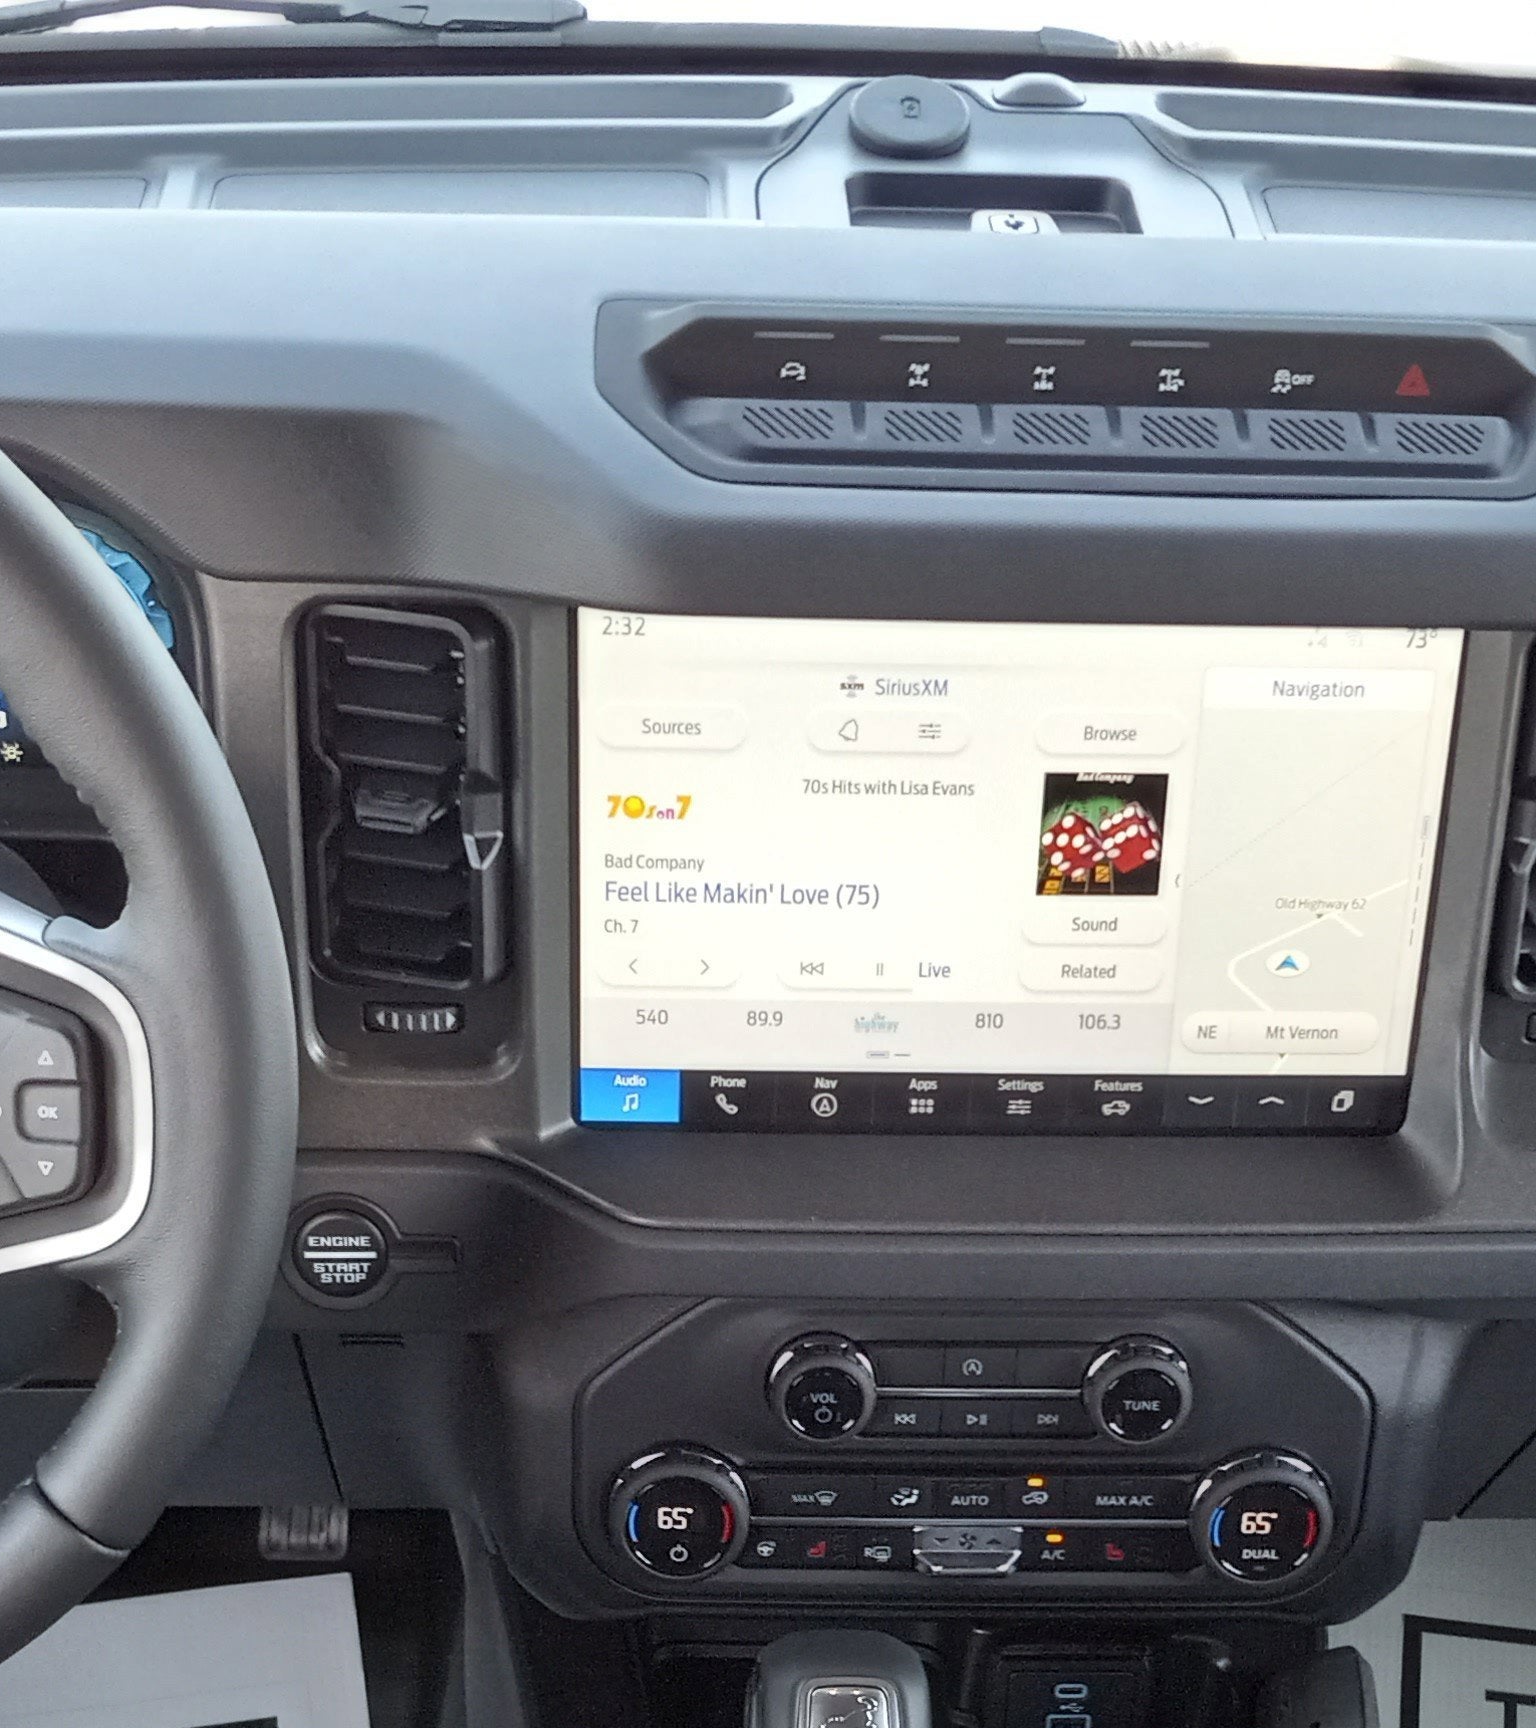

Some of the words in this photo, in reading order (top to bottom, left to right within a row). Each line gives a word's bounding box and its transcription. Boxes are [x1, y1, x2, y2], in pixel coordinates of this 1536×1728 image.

[1292, 374, 1315, 385] OFF
[602, 616, 646, 636] 2:32
[839, 680, 864, 691] sxm
[875, 679, 949, 697] SiriusXM
[1272, 680, 1366, 701] Navigation
[642, 719, 702, 736] Sources
[1083, 726, 1137, 743] Browse
[803, 779, 829, 795] 70s
[832, 780, 860, 795] Hits
[864, 780, 897, 795] with
[901, 780, 929, 796] Lisa
[932, 781, 975, 797] Evans
[604, 854, 633, 869] Bad
[636, 855, 705, 872] Company
[604, 881, 649, 903] Feel
[655, 882, 697, 903] Like
[703, 883, 774, 904] Makin'
[780, 885, 830, 905] Love
[836, 885, 880, 909] (75)
[1275, 898, 1295, 911] Old
[1298, 898, 1348, 914] Highway
[1350, 898, 1367, 910] 62
[604, 919, 627, 934] Ch.
[630, 919, 639, 934] 7
[1072, 917, 1118, 932] Sound
[918, 963, 952, 978] Live
[1061, 964, 1116, 980] Related
[635, 1009, 669, 1025] 540
[746, 1011, 783, 1027] 89.9
[975, 1013, 1004, 1029] 810
[1078, 1014, 1121, 1031] 106.3
[1197, 1025, 1218, 1040] NE
[1266, 1026, 1285, 1040] Mt
[1288, 1026, 1338, 1040] Vernon
[614, 1075, 647, 1088] Audio
[710, 1075, 747, 1089] Phone
[815, 1077, 838, 1090] Nav
[909, 1078, 938, 1093] Apps
[998, 1080, 1044, 1094] Settings
[1094, 1080, 1143, 1093] Features
[37, 1105, 58, 1119] OK
[308, 1236, 371, 1248] ENGINE
[313, 1263, 371, 1273] START
[320, 1272, 366, 1283] STOP
[810, 1393, 837, 1404] VOL
[1123, 1400, 1160, 1411] TUNE
[951, 1495, 989, 1506] AUTO
[1096, 1495, 1127, 1506] MAX
[1128, 1495, 1154, 1507] A/C
[1041, 1549, 1065, 1561] A/C
[1241, 1549, 1280, 1561] DUAL
